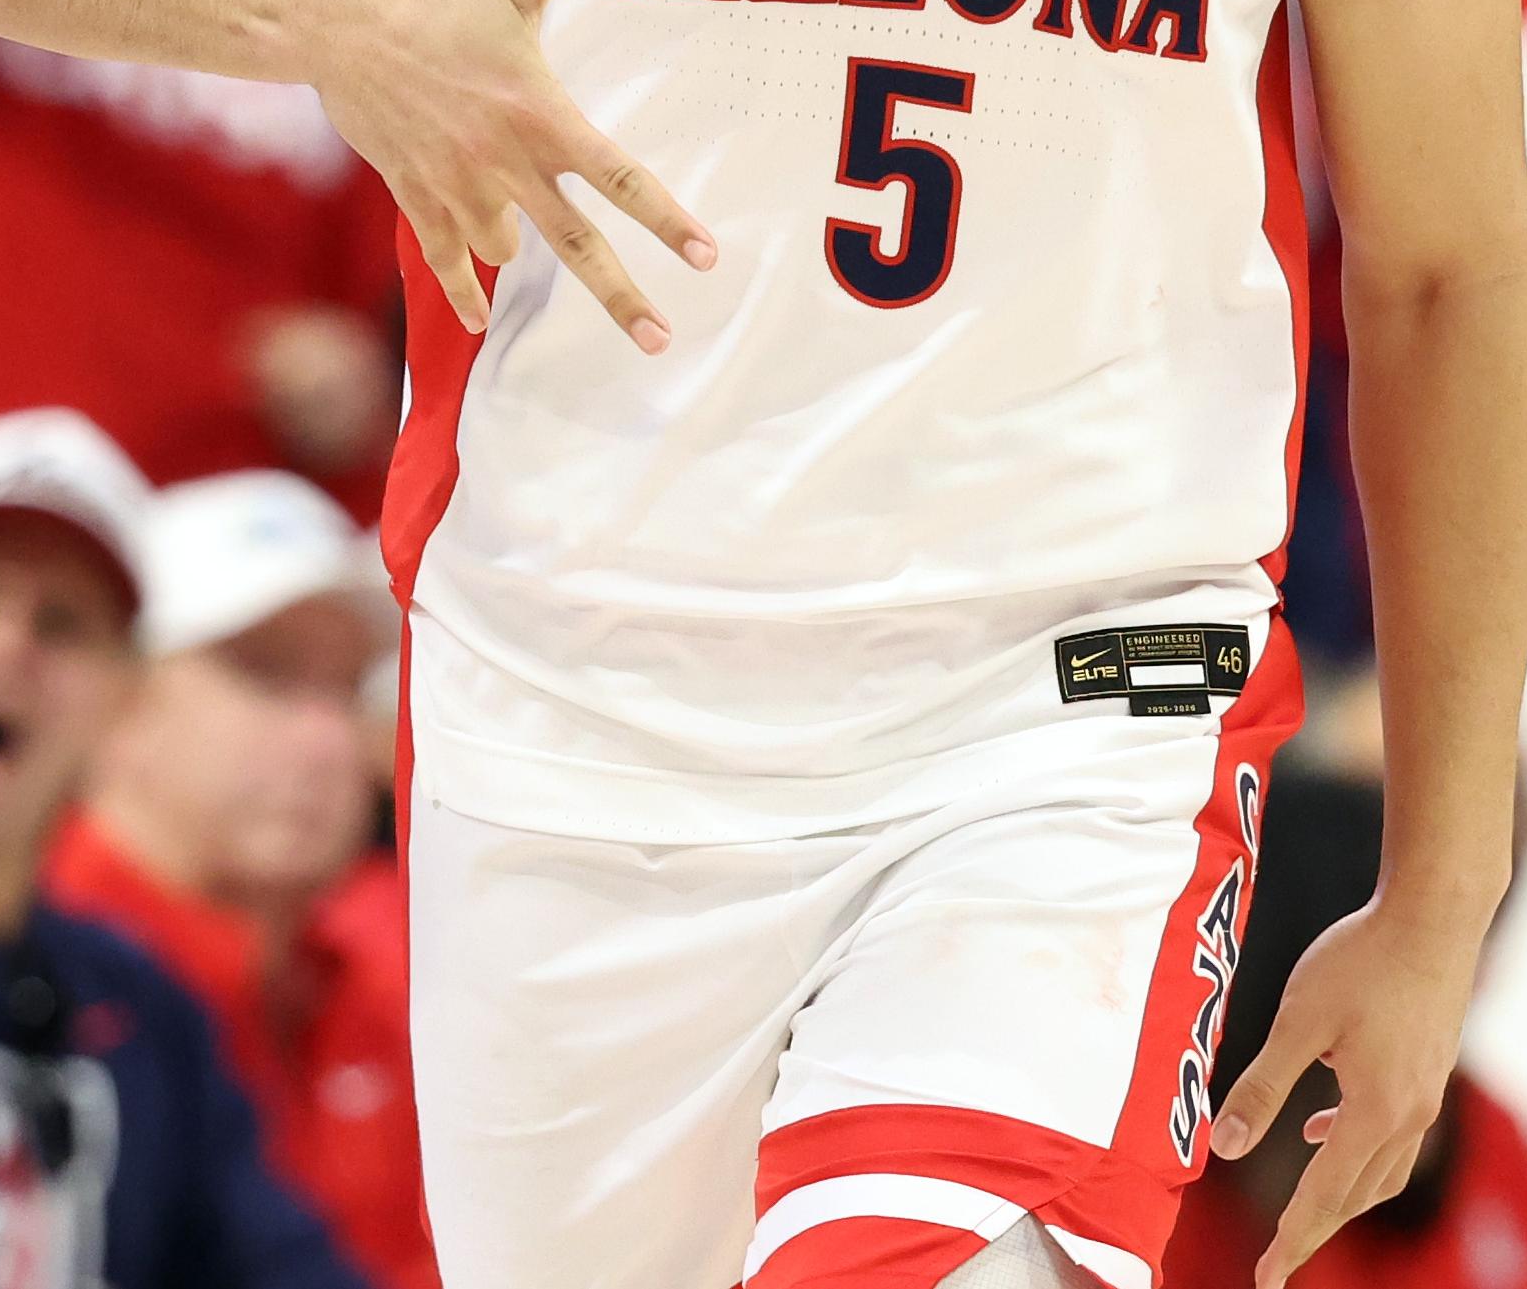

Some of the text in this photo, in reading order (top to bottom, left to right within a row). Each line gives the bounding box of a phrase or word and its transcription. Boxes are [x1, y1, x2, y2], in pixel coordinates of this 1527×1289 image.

[824, 56, 976, 310] 5
[1126, 633, 1200, 646] ENGINEERED
[1217, 647, 1242, 673] 46
